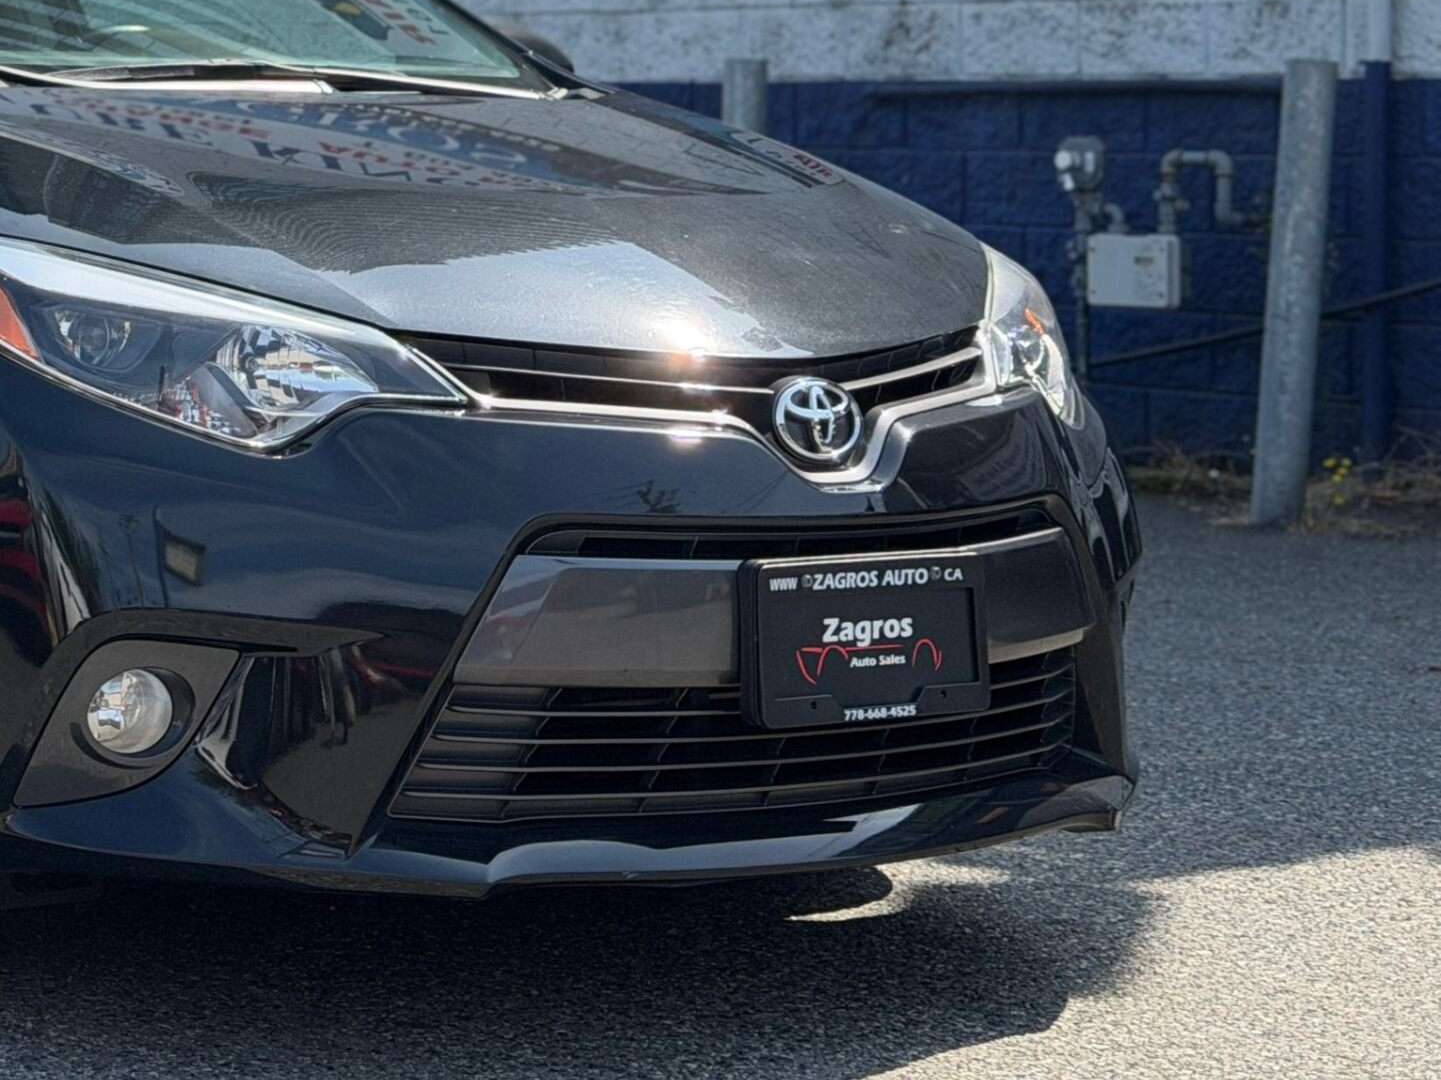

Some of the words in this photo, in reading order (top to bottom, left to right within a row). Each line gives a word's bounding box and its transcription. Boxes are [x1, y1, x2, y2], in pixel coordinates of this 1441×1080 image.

[813, 570, 878, 590] ZAGROS
[882, 567, 929, 586] AUTO
[822, 617, 913, 647] Zagros
[849, 654, 876, 668] Auto
[879, 652, 906, 666] Sales
[843, 704, 916, 720] 778-668-4525
